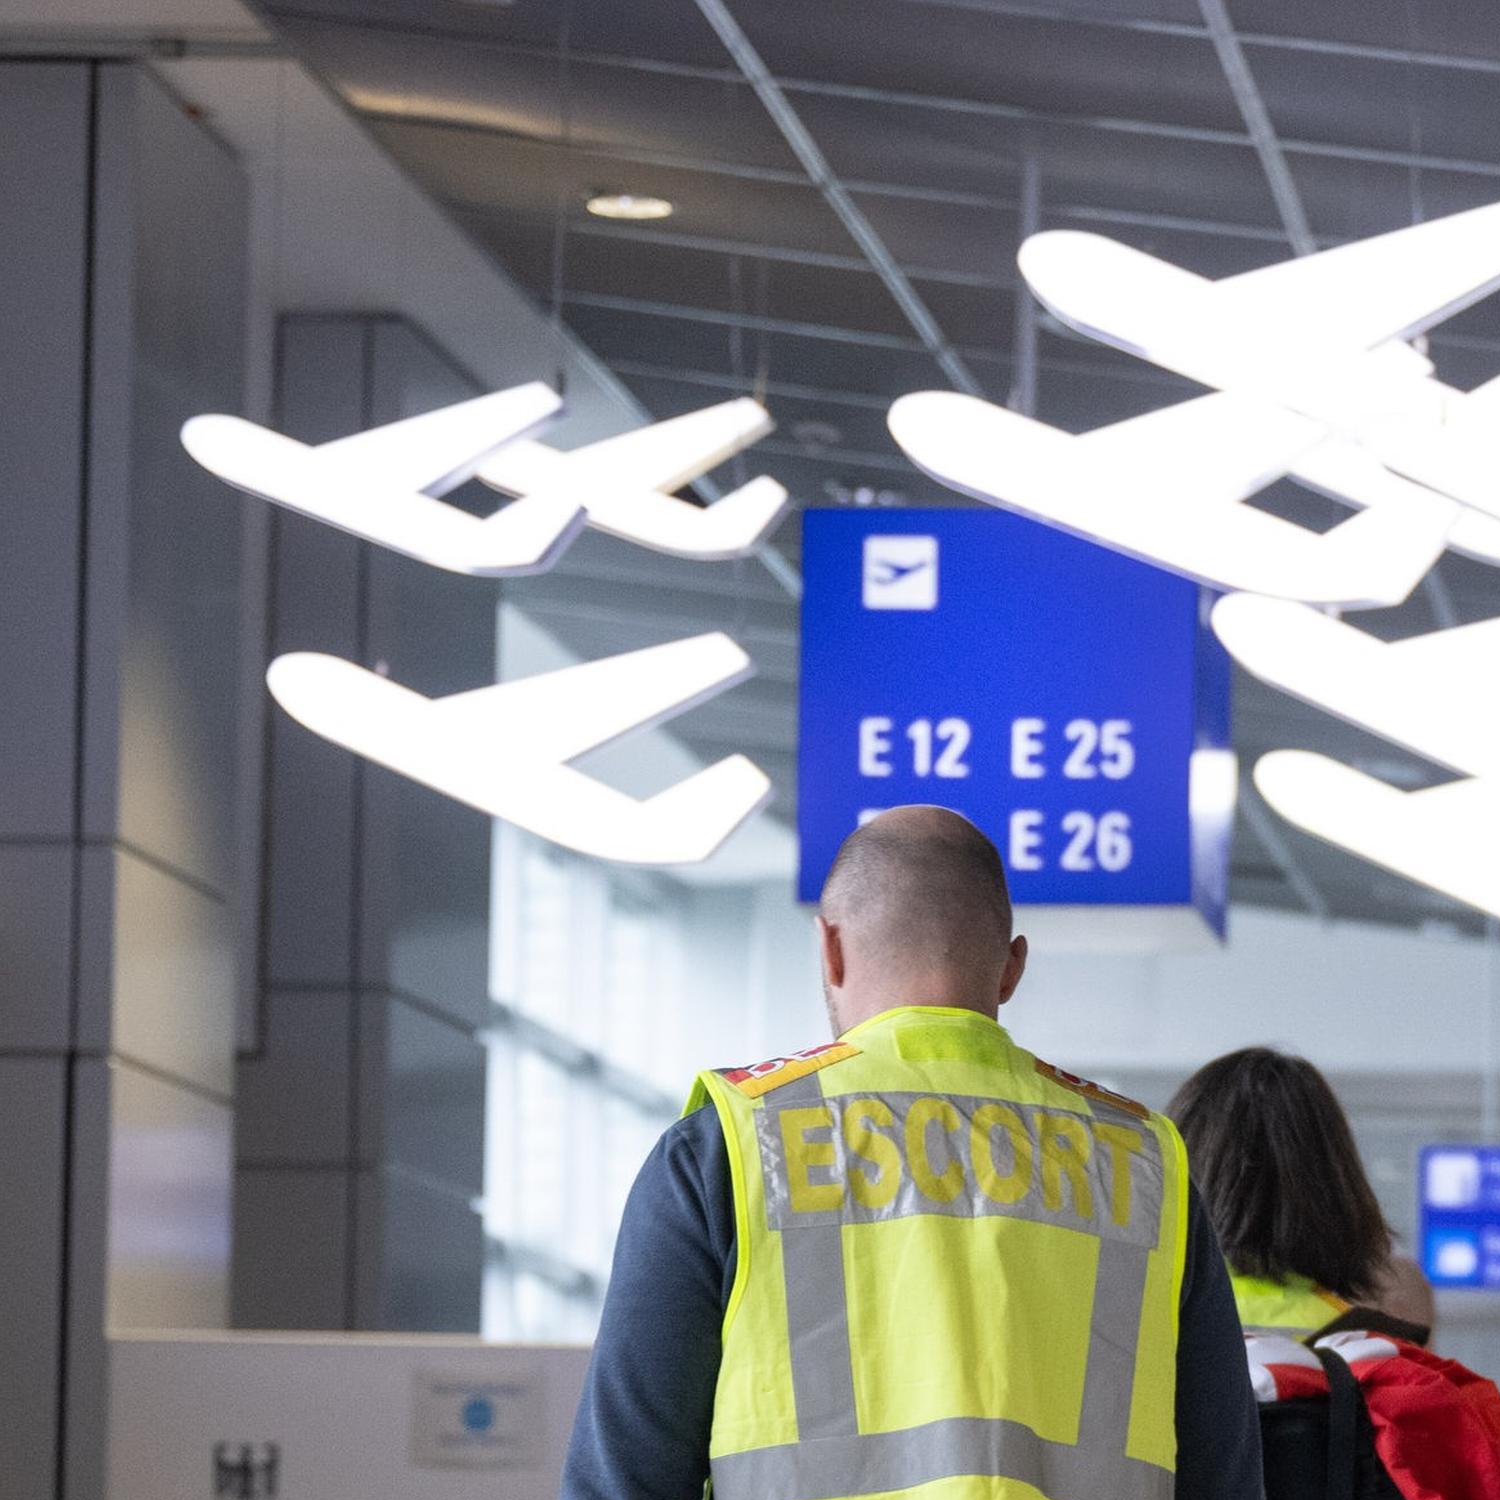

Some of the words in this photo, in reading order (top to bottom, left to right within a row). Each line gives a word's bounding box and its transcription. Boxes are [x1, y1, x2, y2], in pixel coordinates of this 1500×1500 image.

[858, 716, 894, 778] E
[906, 716, 972, 779] 12
[1010, 717, 1047, 780] E
[1062, 718, 1136, 781] 25
[1008, 809, 1044, 871] E
[1059, 810, 1134, 872] 26
[778, 1098, 1143, 1228] ESCORT
